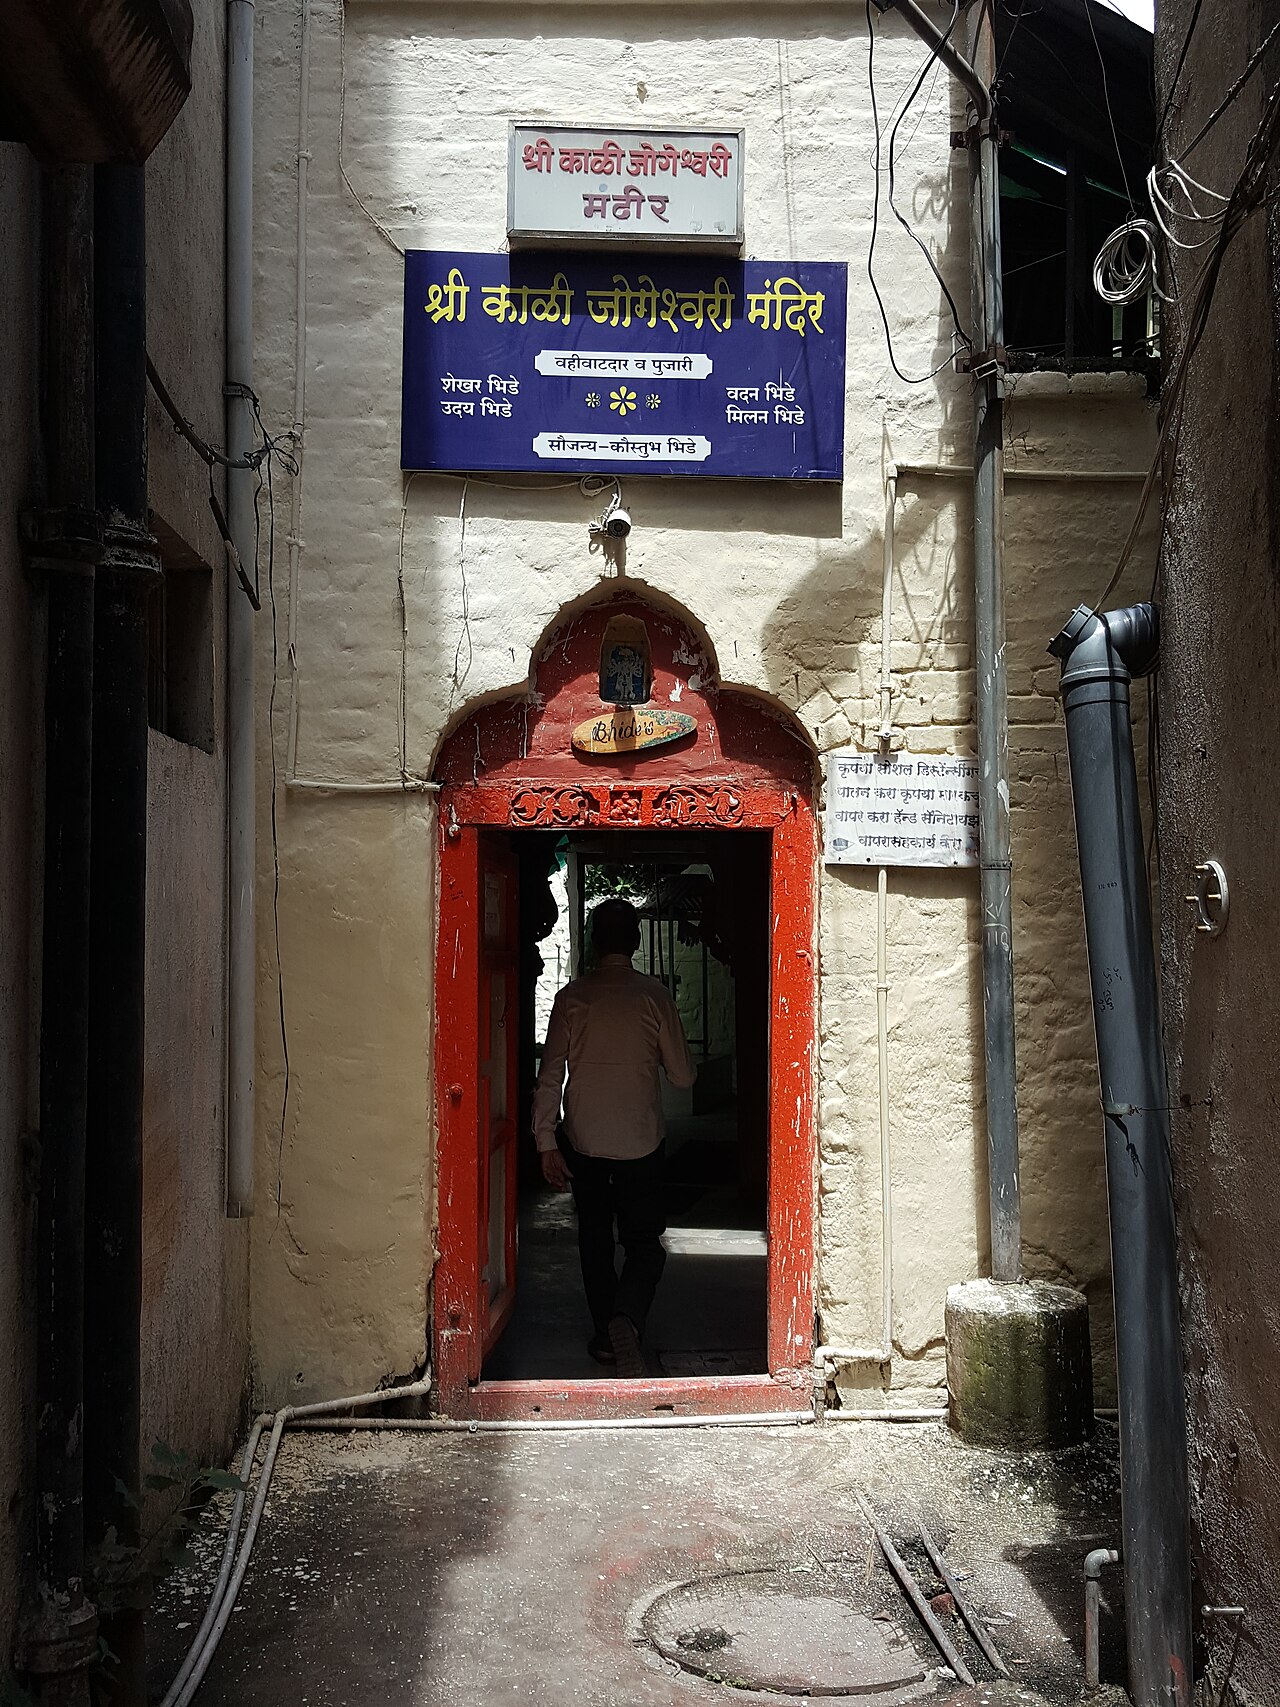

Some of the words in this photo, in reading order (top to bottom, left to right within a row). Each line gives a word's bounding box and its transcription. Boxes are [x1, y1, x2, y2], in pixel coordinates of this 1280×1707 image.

[522, 137, 554, 173] श्री
[559, 140, 625, 175] काळी
[626, 142, 732, 179] जोगेश्वरी
[424, 267, 470, 324] श्री
[481, 271, 574, 326] काळी
[586, 274, 735, 333] जोगेश्वरी
[747, 277, 825, 337] मंदिर
[555, 354, 629, 372] वहीवाटदार
[634, 359, 646, 371] व
[652, 356, 693, 376] पुजारी
[440, 372, 482, 394] शेखर
[487, 374, 519, 395] भिडे
[726, 387, 759, 404] वदन
[764, 381, 796, 402] भिडे
[440, 401, 475, 418] उदय
[480, 396, 512, 418] भिडे
[726, 404, 769, 424] मिलन
[773, 405, 805, 425] भिडे
[667, 437, 696, 455] भिडे
[591, 716, 654, 744] Bhide's
[835, 810, 864, 823] वापर
[867, 811, 890, 824] करा
